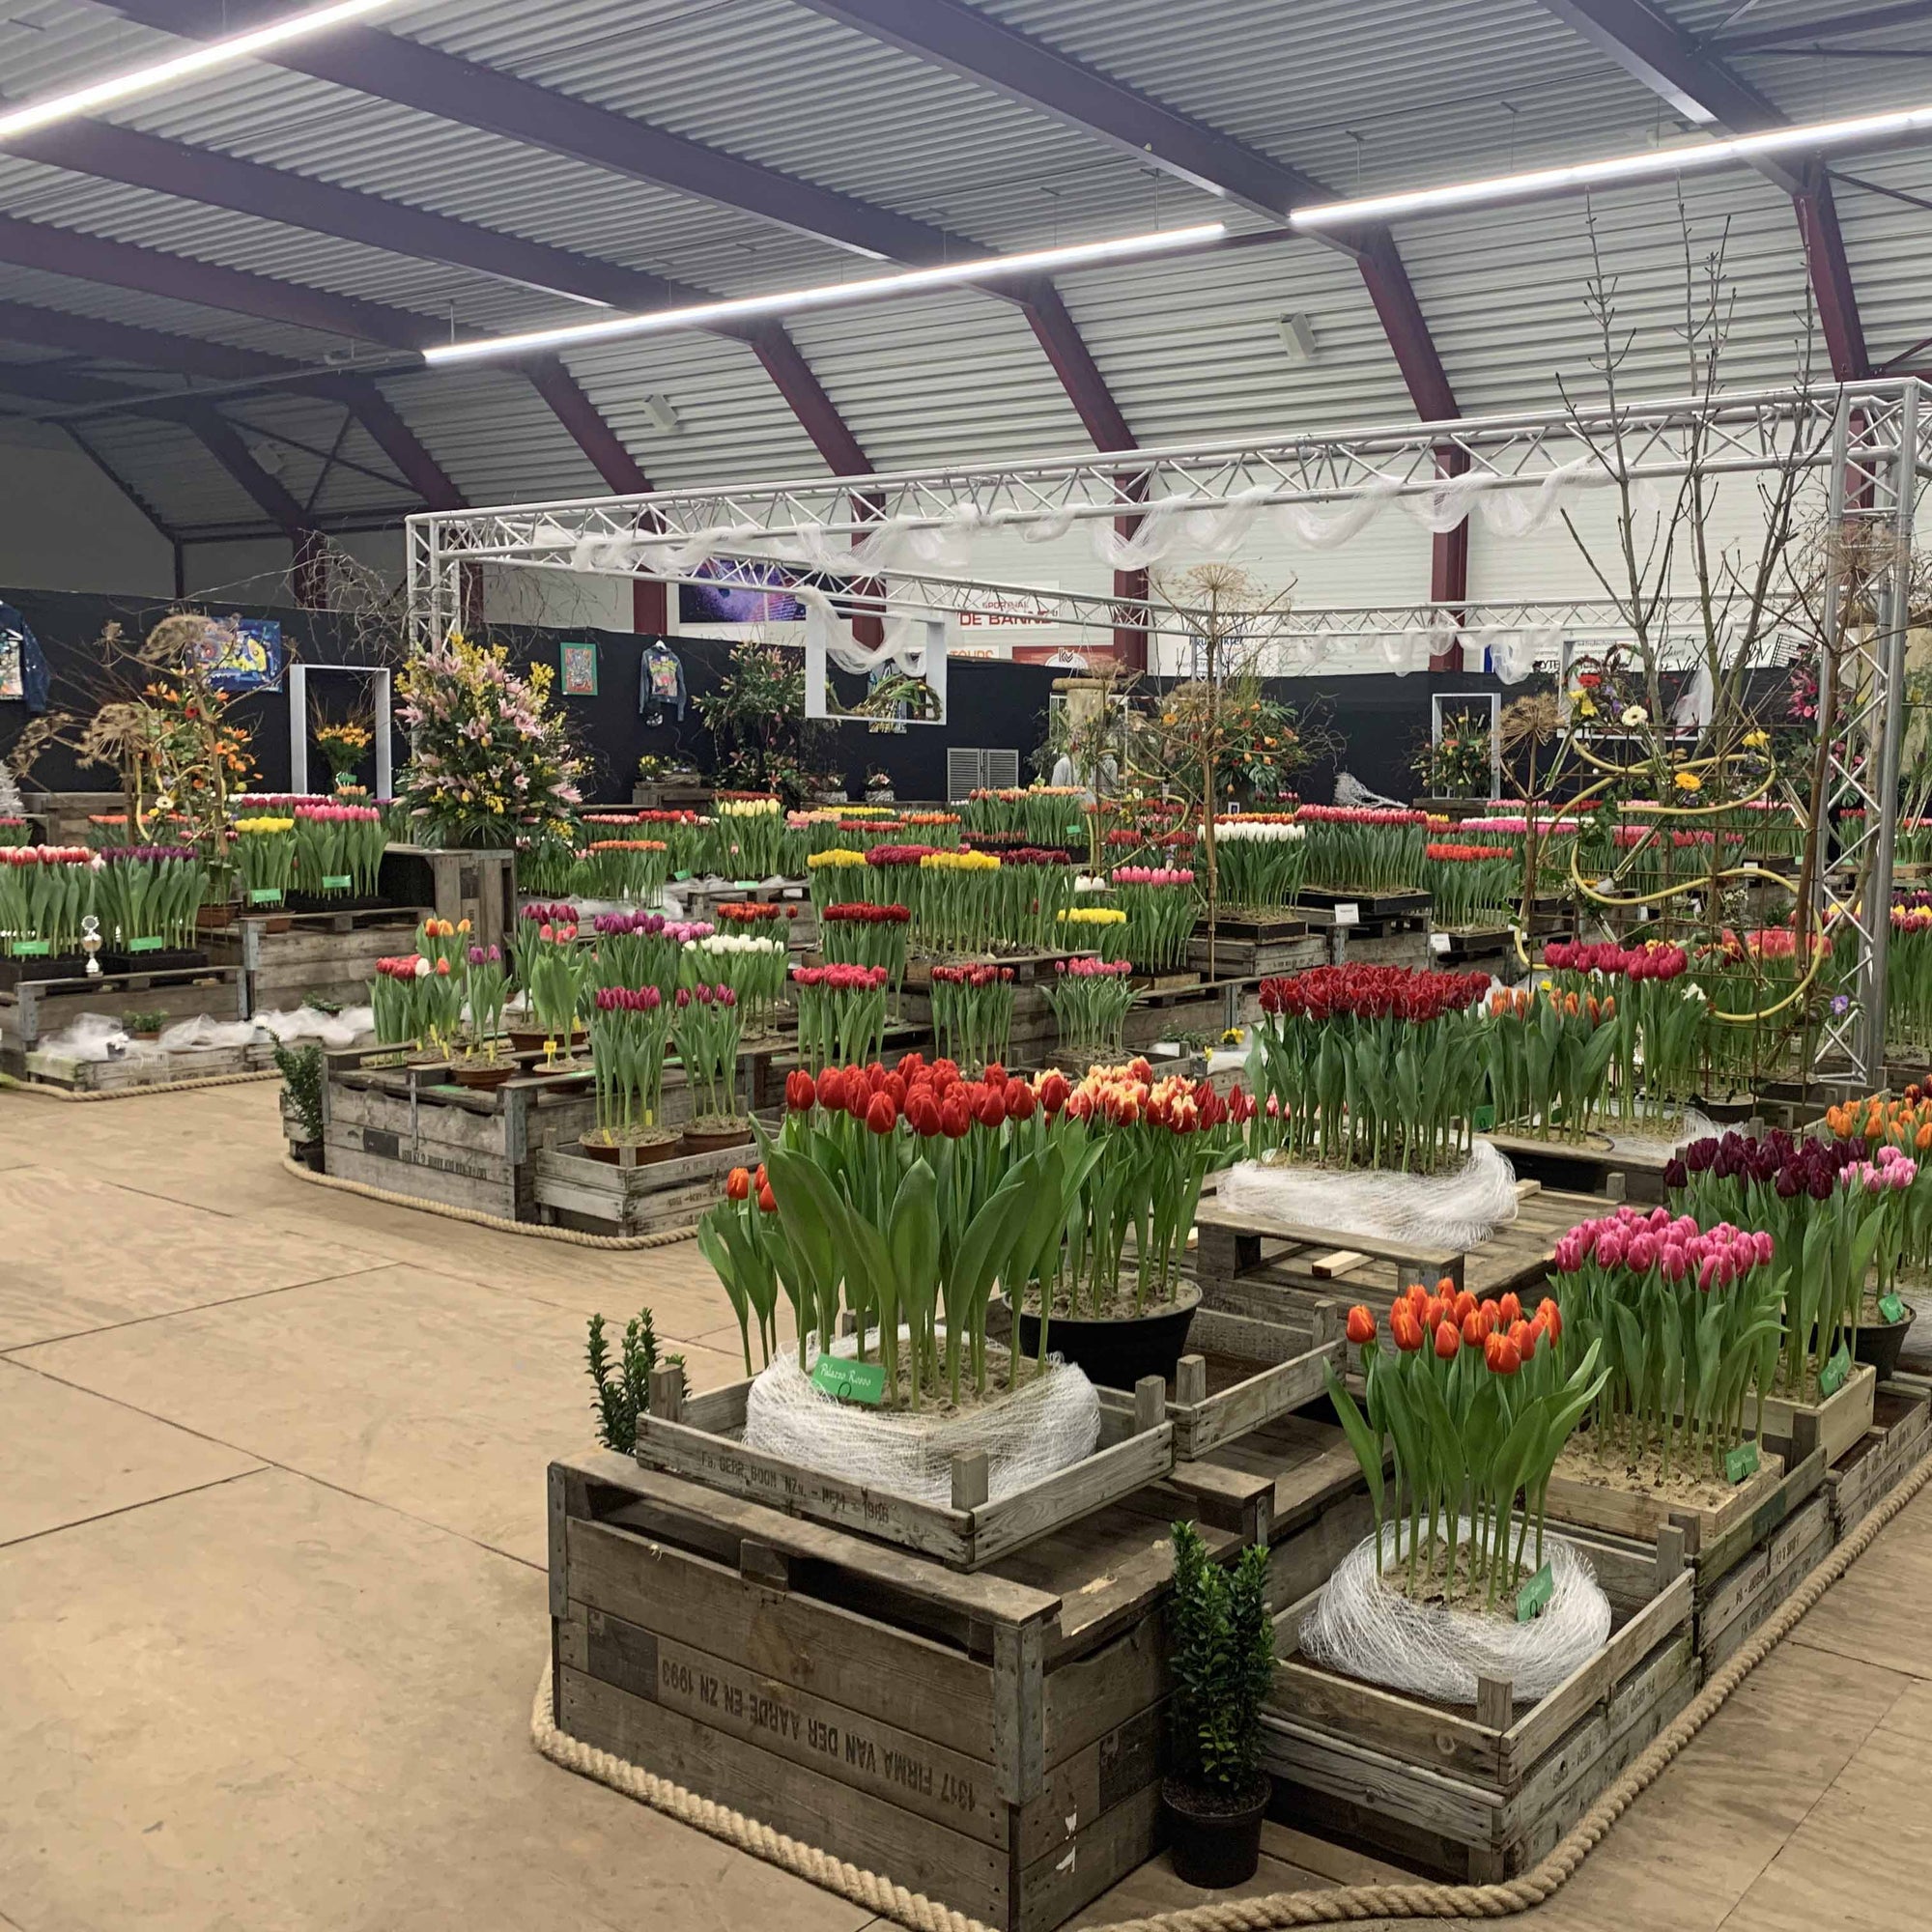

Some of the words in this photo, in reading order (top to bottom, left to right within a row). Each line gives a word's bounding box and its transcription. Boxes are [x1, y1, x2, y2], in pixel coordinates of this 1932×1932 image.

[700, 1673, 719, 1708] ZN
[724, 1685, 744, 1719] EN
[750, 1692, 800, 1741] AARDE
[808, 1717, 838, 1757] DER
[845, 1732, 877, 1774] VAN
[883, 1747, 934, 1797] FIRMA
